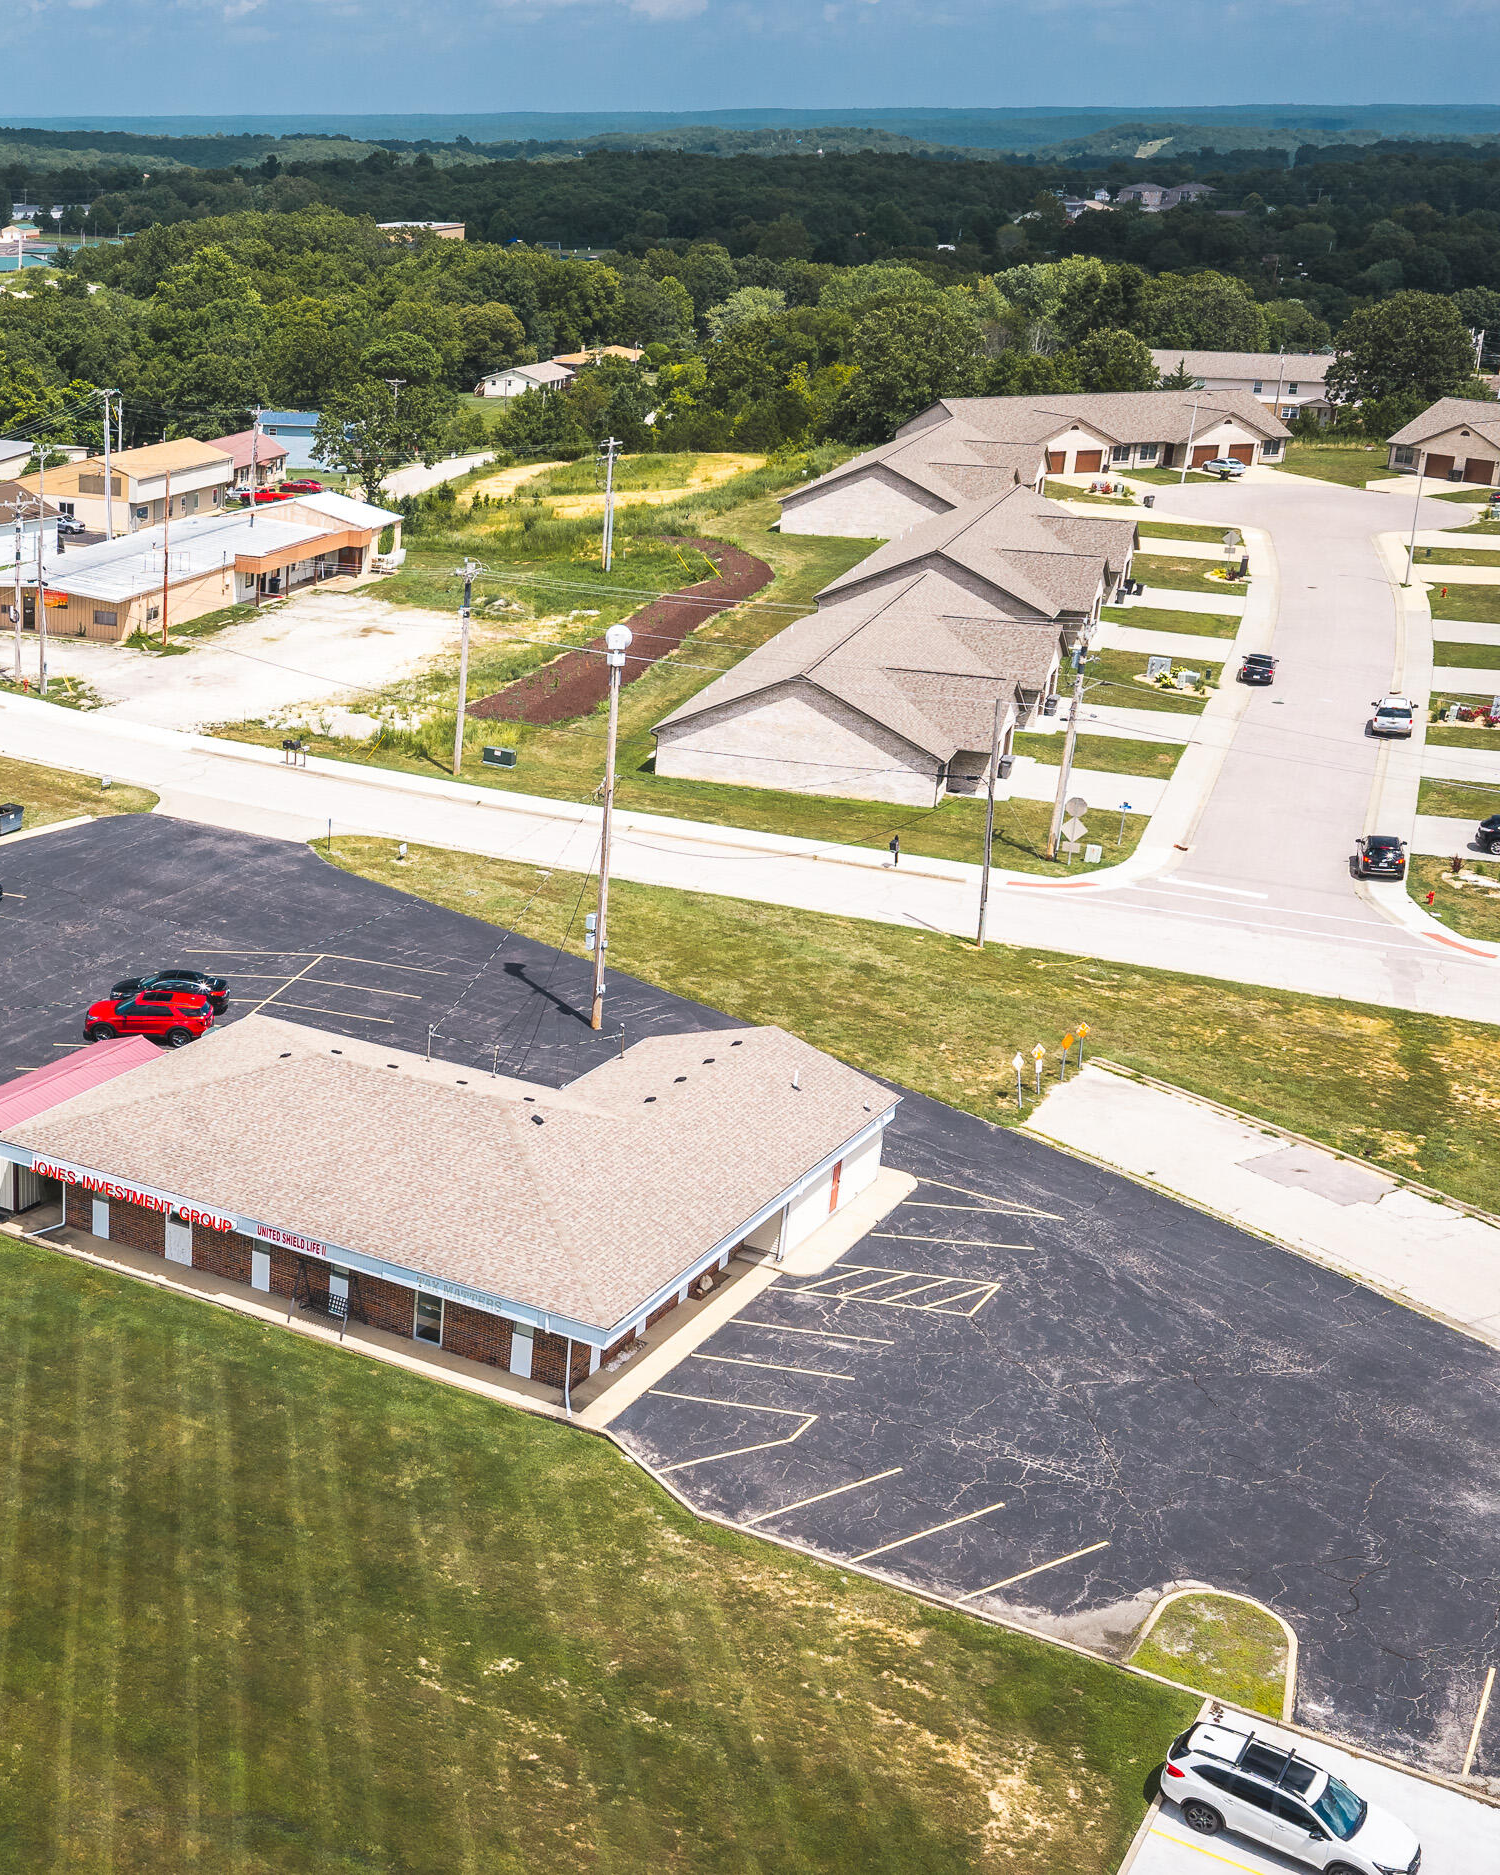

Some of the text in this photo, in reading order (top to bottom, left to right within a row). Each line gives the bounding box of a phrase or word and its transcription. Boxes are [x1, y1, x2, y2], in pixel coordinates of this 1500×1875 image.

[29, 1158, 233, 1233] JONES INVESTMENT GROUP
[257, 1225, 280, 1243] UNITED
[282, 1233, 305, 1250] SHIELD
[306, 1239, 320, 1254] LIFE
[444, 1284, 502, 1312] MATTERS
